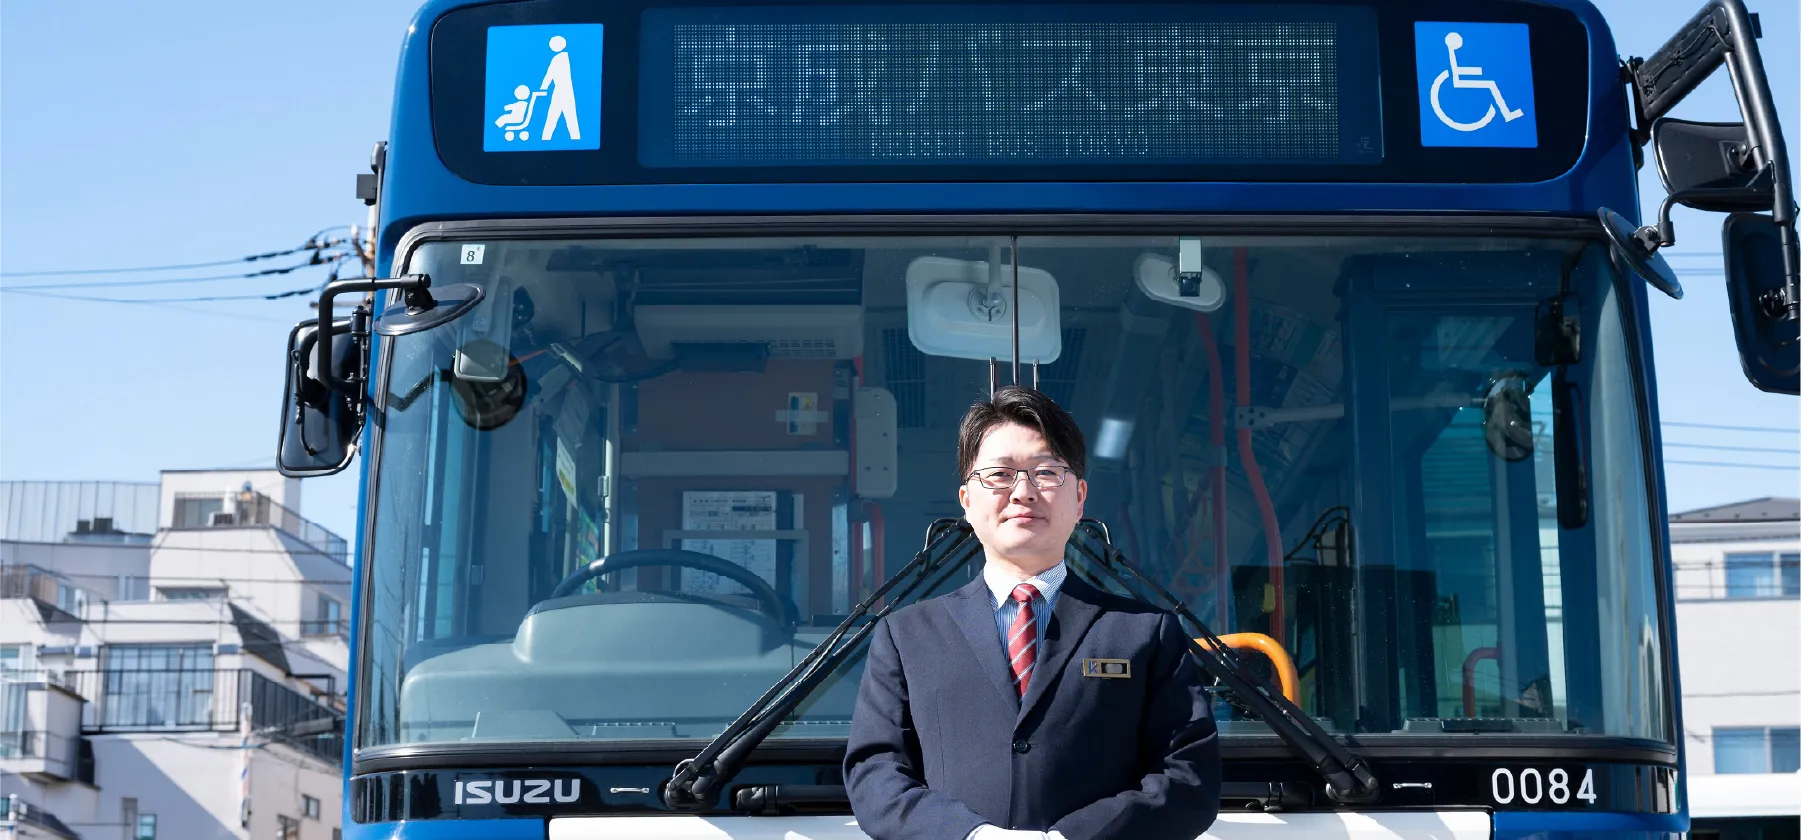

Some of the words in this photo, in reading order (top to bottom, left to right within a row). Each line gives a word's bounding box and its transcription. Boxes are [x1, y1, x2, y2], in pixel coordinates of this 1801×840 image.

[679, 26, 1334, 126] 京成バス東京
[989, 131, 1037, 156] BUS
[1058, 131, 1149, 155] TOKYO
[466, 250, 475, 262] 8
[454, 779, 581, 805] ISUZU
[1491, 768, 1597, 805] 0084
